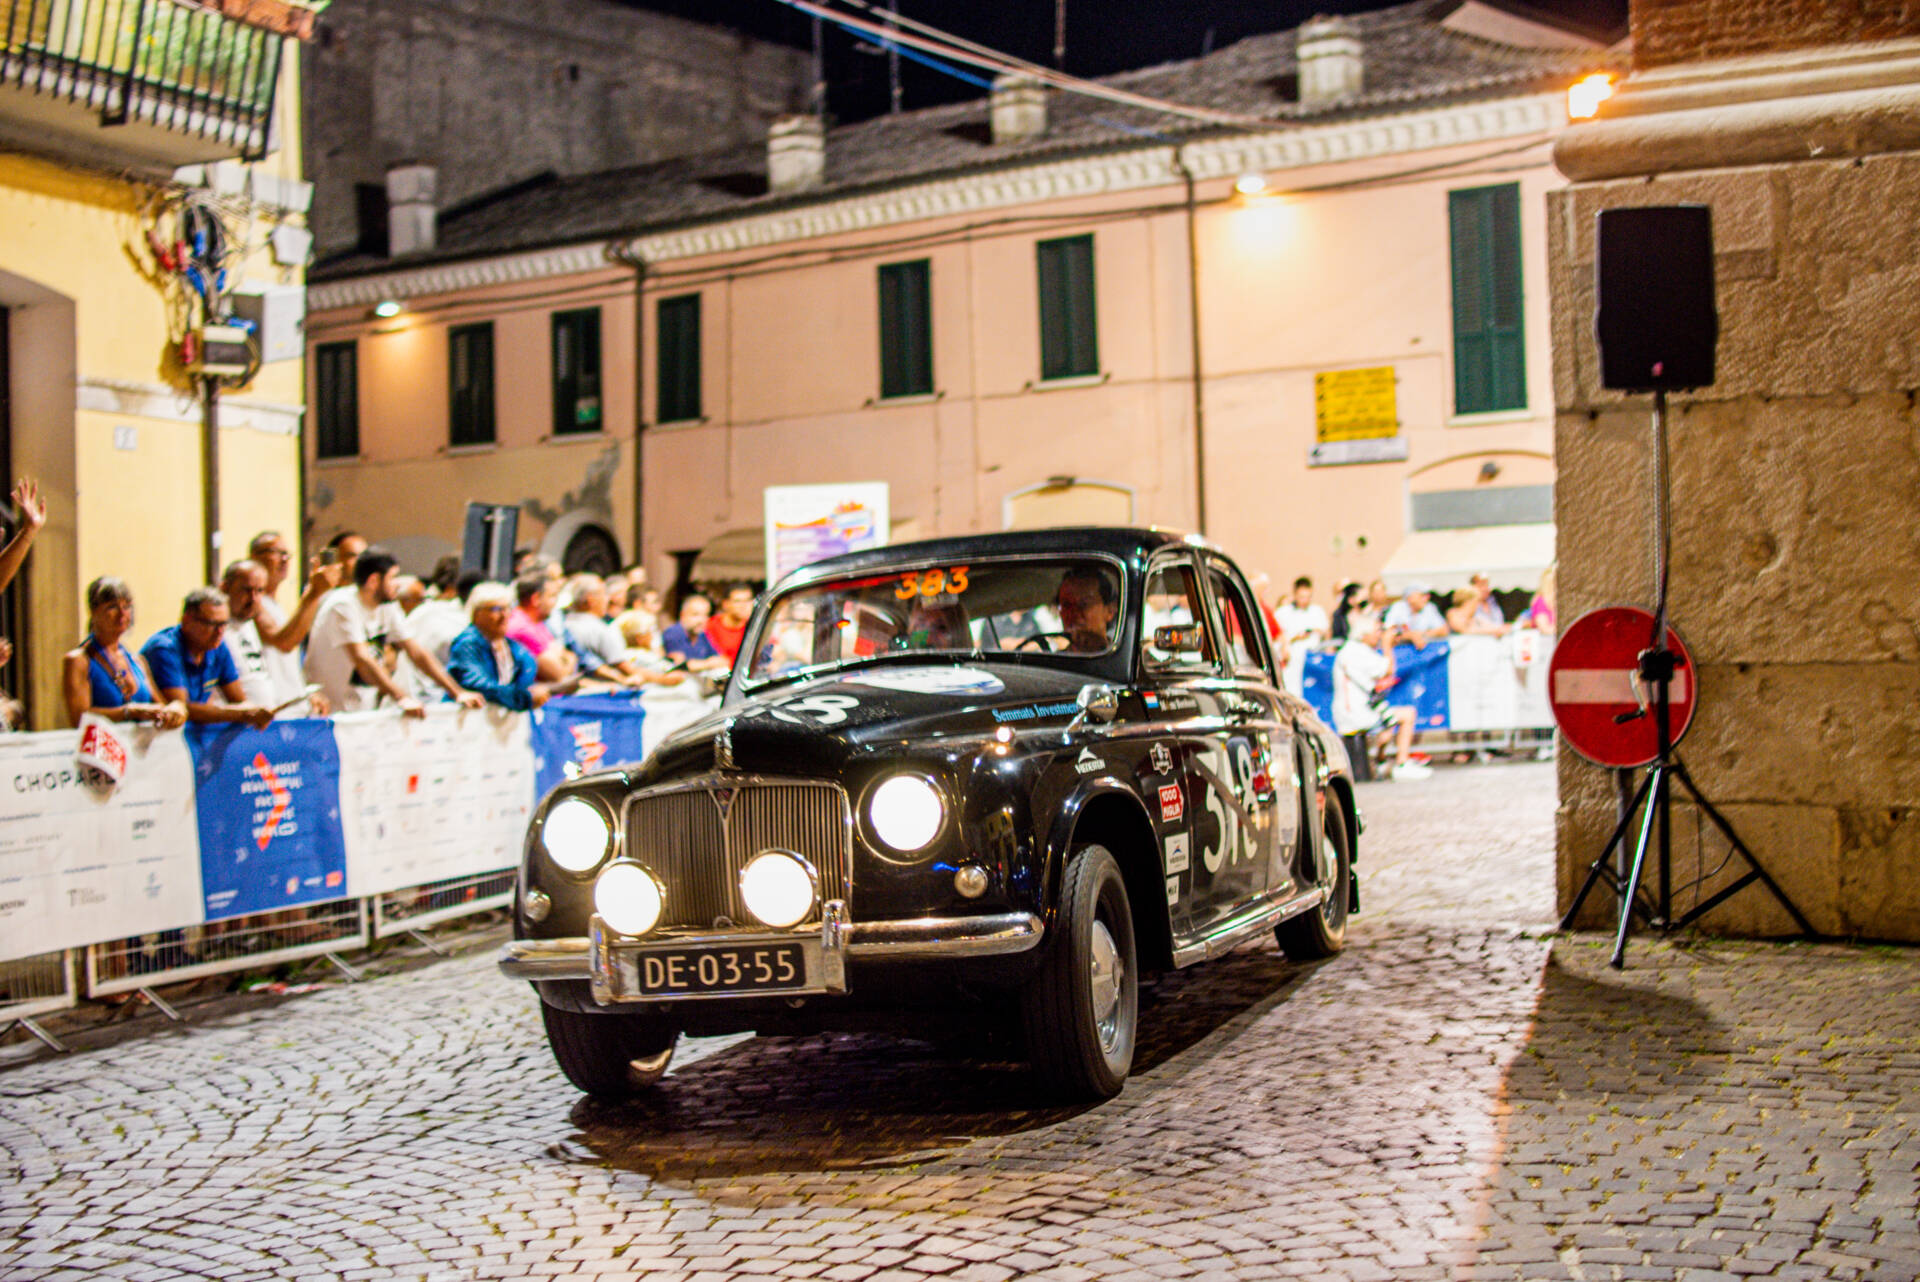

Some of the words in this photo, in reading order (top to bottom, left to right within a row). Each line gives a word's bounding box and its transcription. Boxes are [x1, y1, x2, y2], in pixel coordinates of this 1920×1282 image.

[895, 565, 970, 600] 383
[1033, 703, 1080, 718] Investmen
[1161, 788, 1177, 803] 1000
[644, 950, 796, 989] DE-03-55
